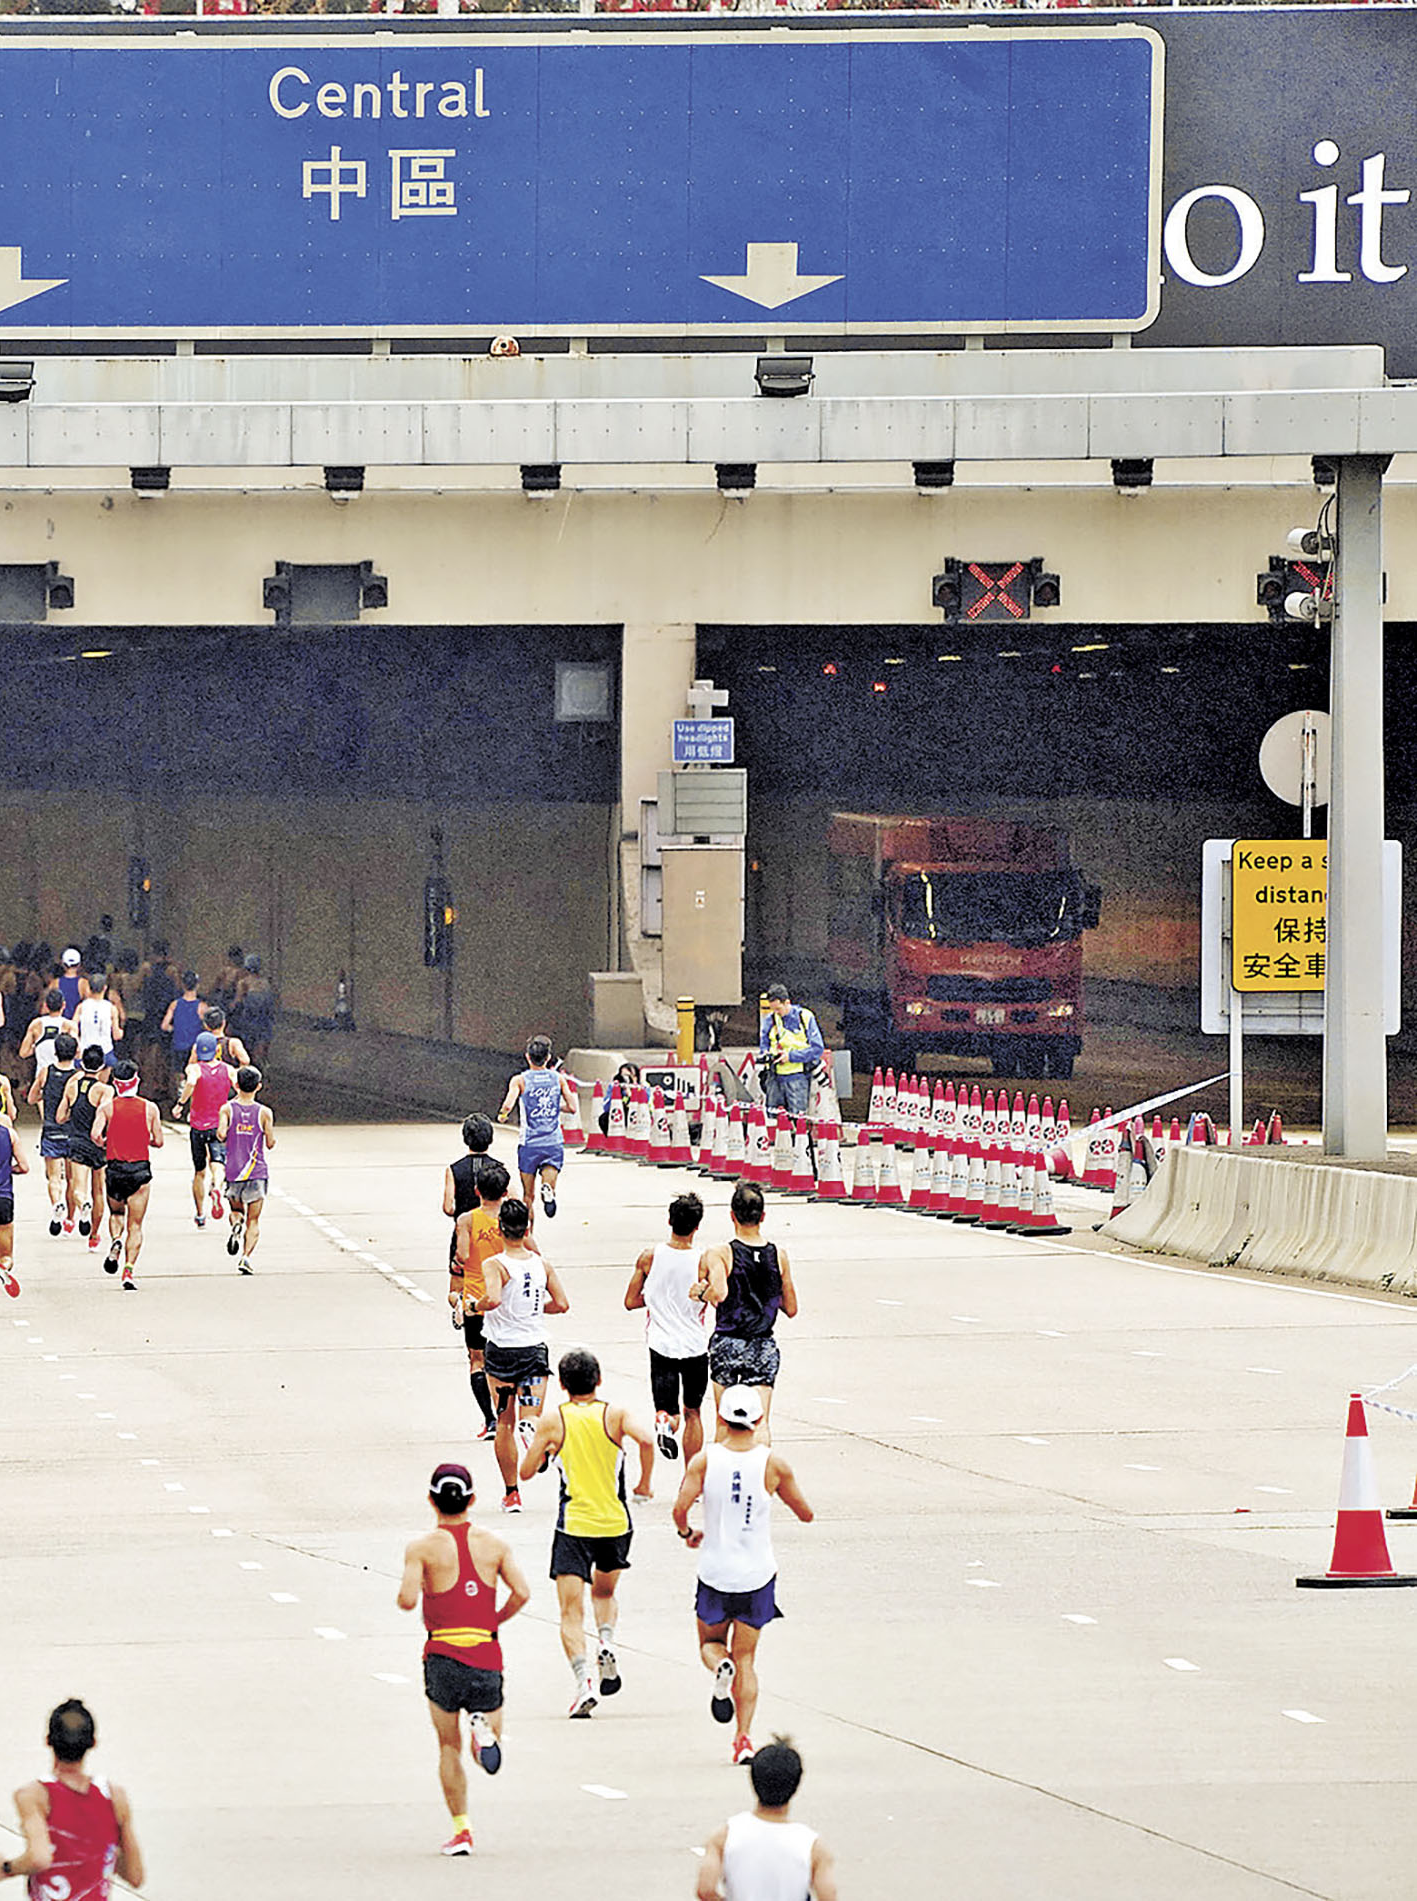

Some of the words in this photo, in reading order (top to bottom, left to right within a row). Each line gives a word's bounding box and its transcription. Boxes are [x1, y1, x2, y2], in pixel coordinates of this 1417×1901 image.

[269, 67, 491, 119] Central
[302, 145, 458, 220] 中區
[1297, 139, 1411, 283] it
[676, 723, 695, 732] Use
[697, 723, 730, 734] dipped
[677, 734, 730, 744] headlights
[1238, 851, 1293, 872] Keep
[1301, 855, 1313, 869] a
[1255, 886, 1327, 904] distan
[1273, 916, 1326, 944] 保持
[528, 1086, 558, 1097] LOVE
